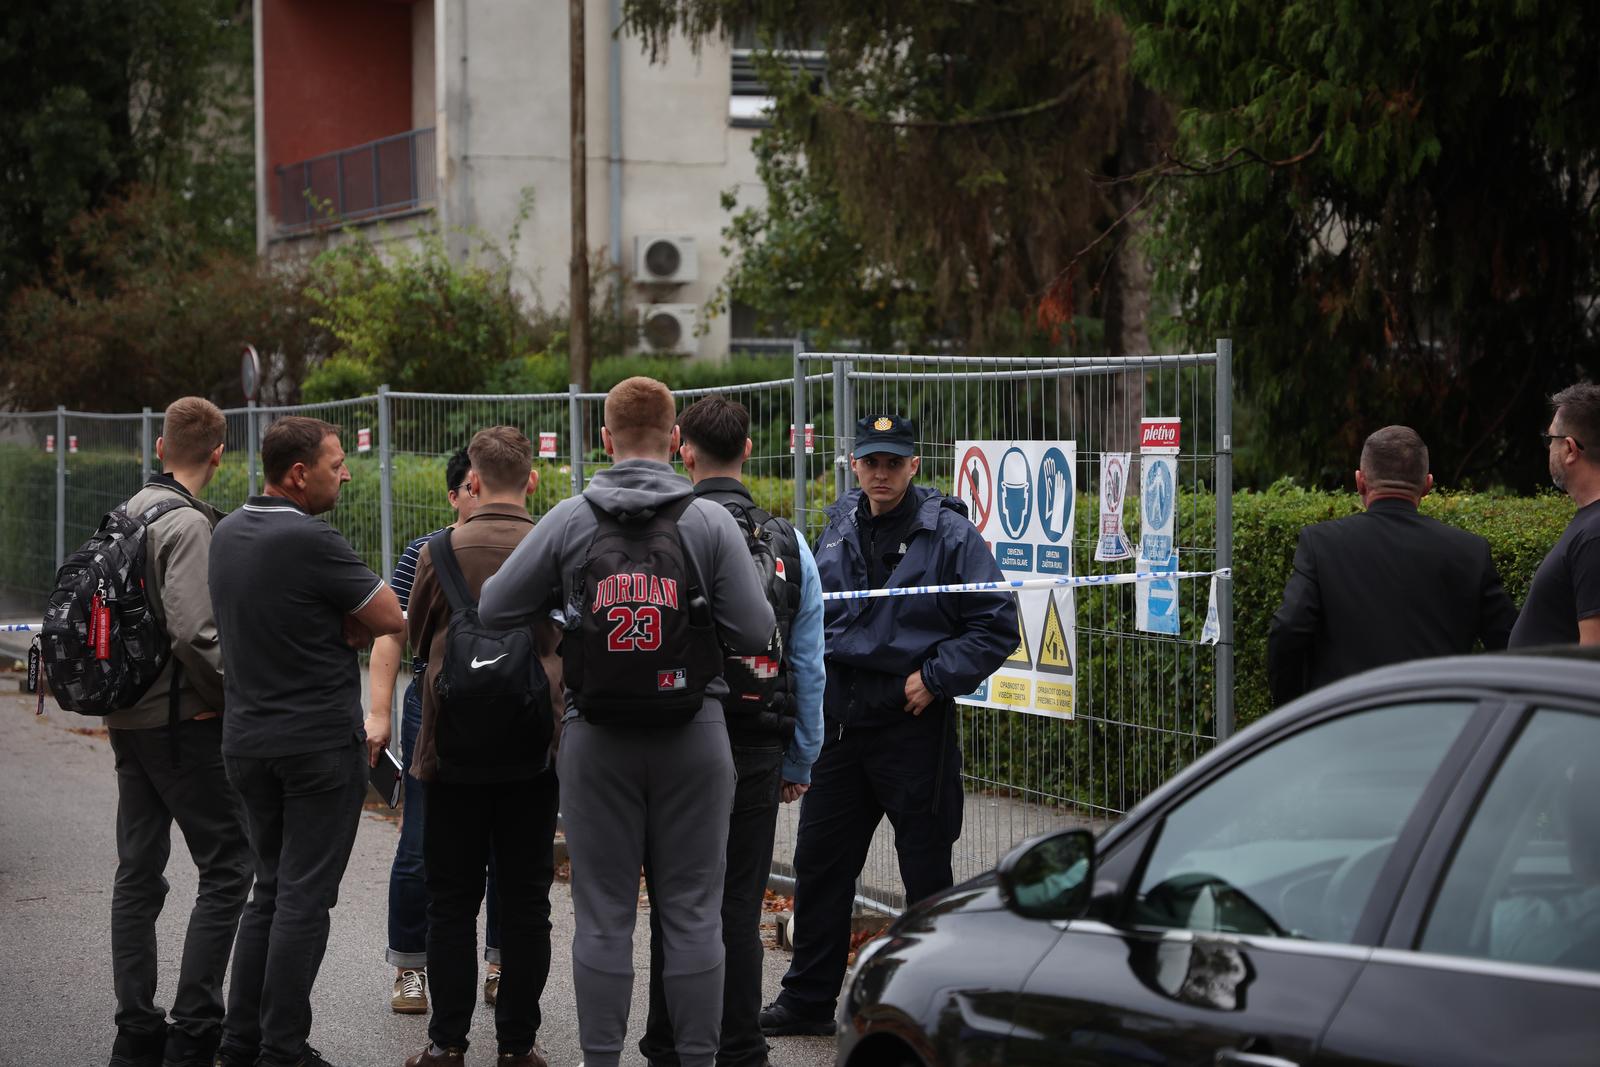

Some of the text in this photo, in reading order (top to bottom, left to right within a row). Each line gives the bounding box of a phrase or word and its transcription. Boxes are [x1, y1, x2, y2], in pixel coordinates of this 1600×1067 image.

[1142, 424, 1176, 444] pletivo
[592, 573, 679, 614] JORDAN
[607, 606, 662, 651] 23
[675, 670, 683, 679] 23
